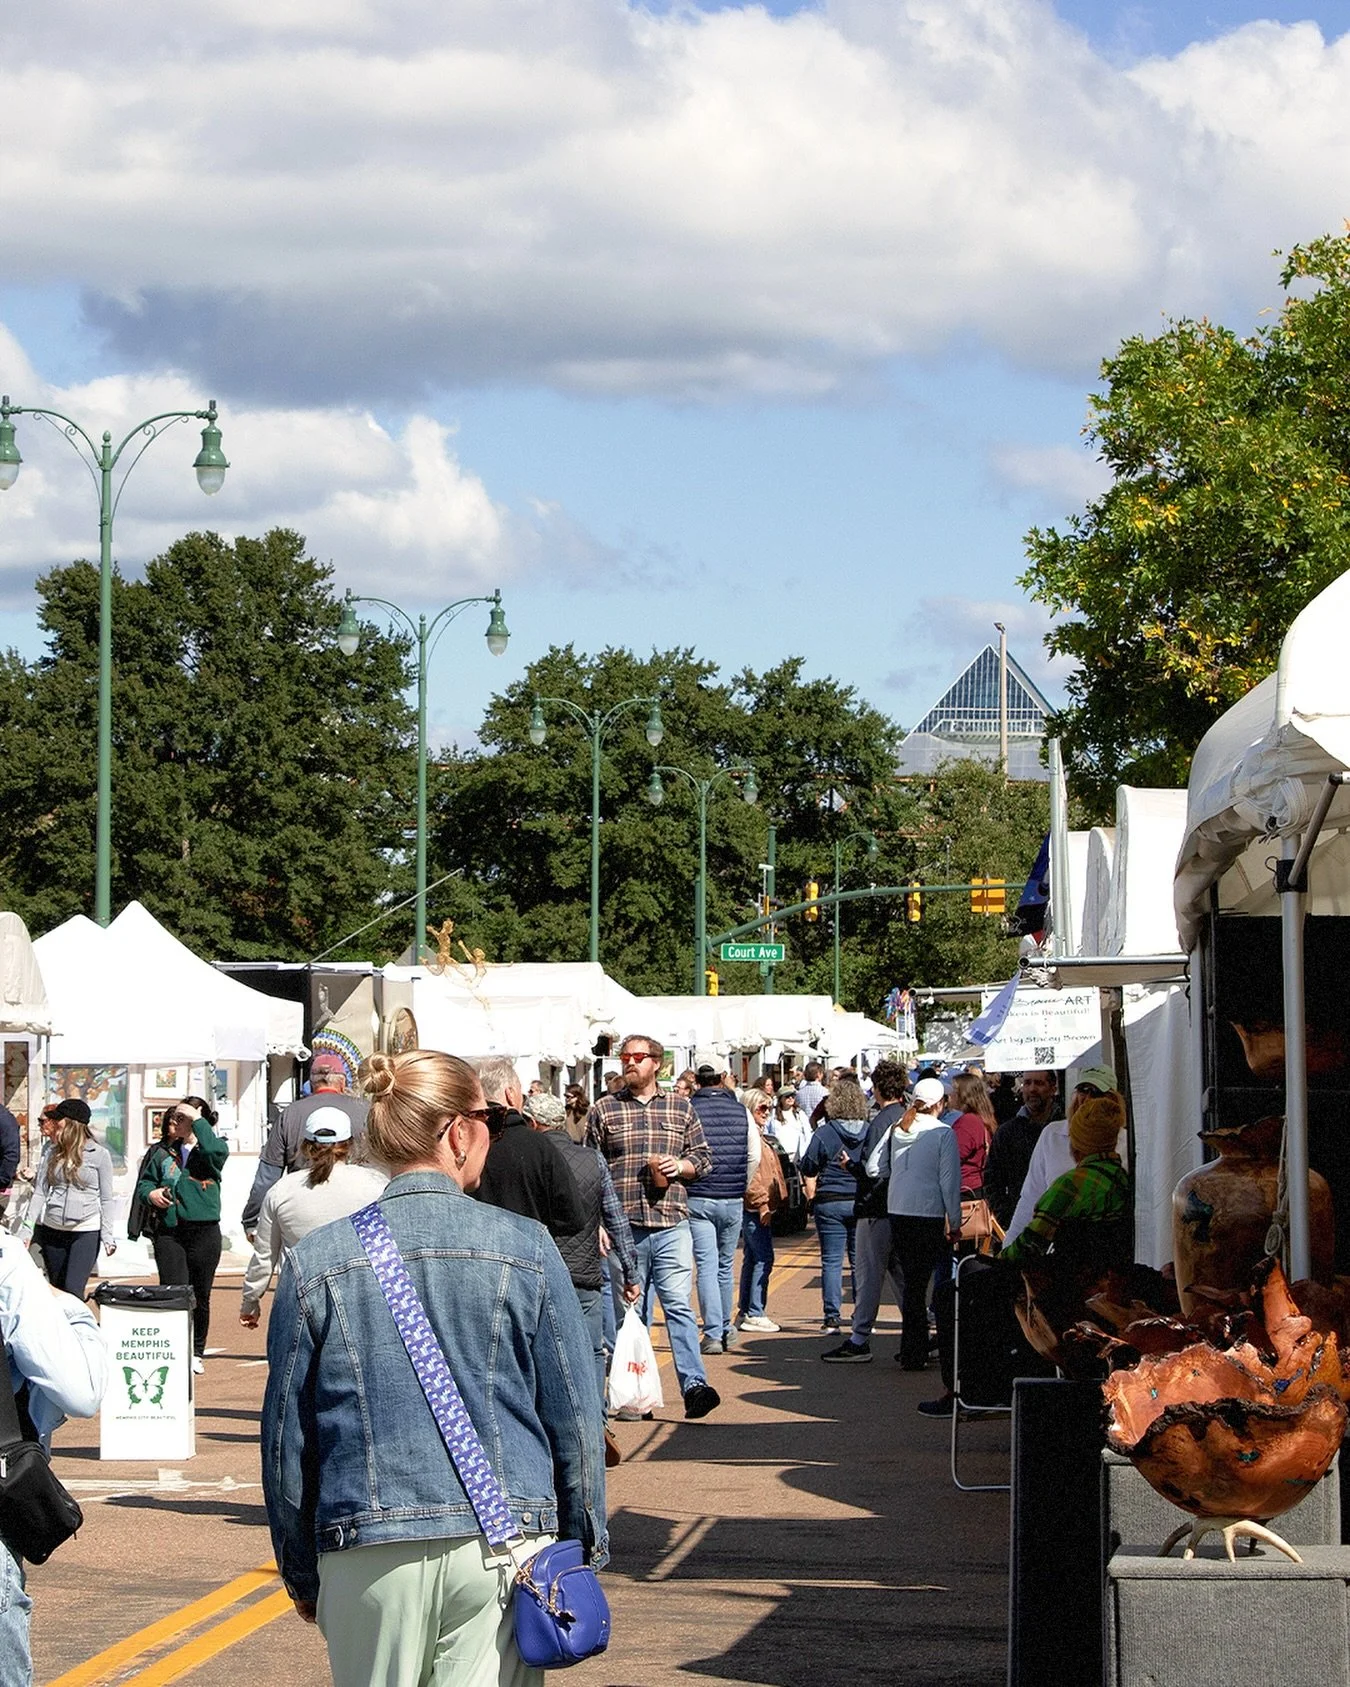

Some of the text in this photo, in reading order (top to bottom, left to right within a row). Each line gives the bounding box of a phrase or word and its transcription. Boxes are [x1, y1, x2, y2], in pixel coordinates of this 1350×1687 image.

[728, 946, 778, 958] Court Ave
[1064, 995, 1092, 1005] ART
[1009, 1035, 1024, 1046] by
[132, 1327, 160, 1336] KEEP
[121, 1339, 170, 1348] MEMPHIS
[116, 1351, 176, 1360] BEAUTIFUL
